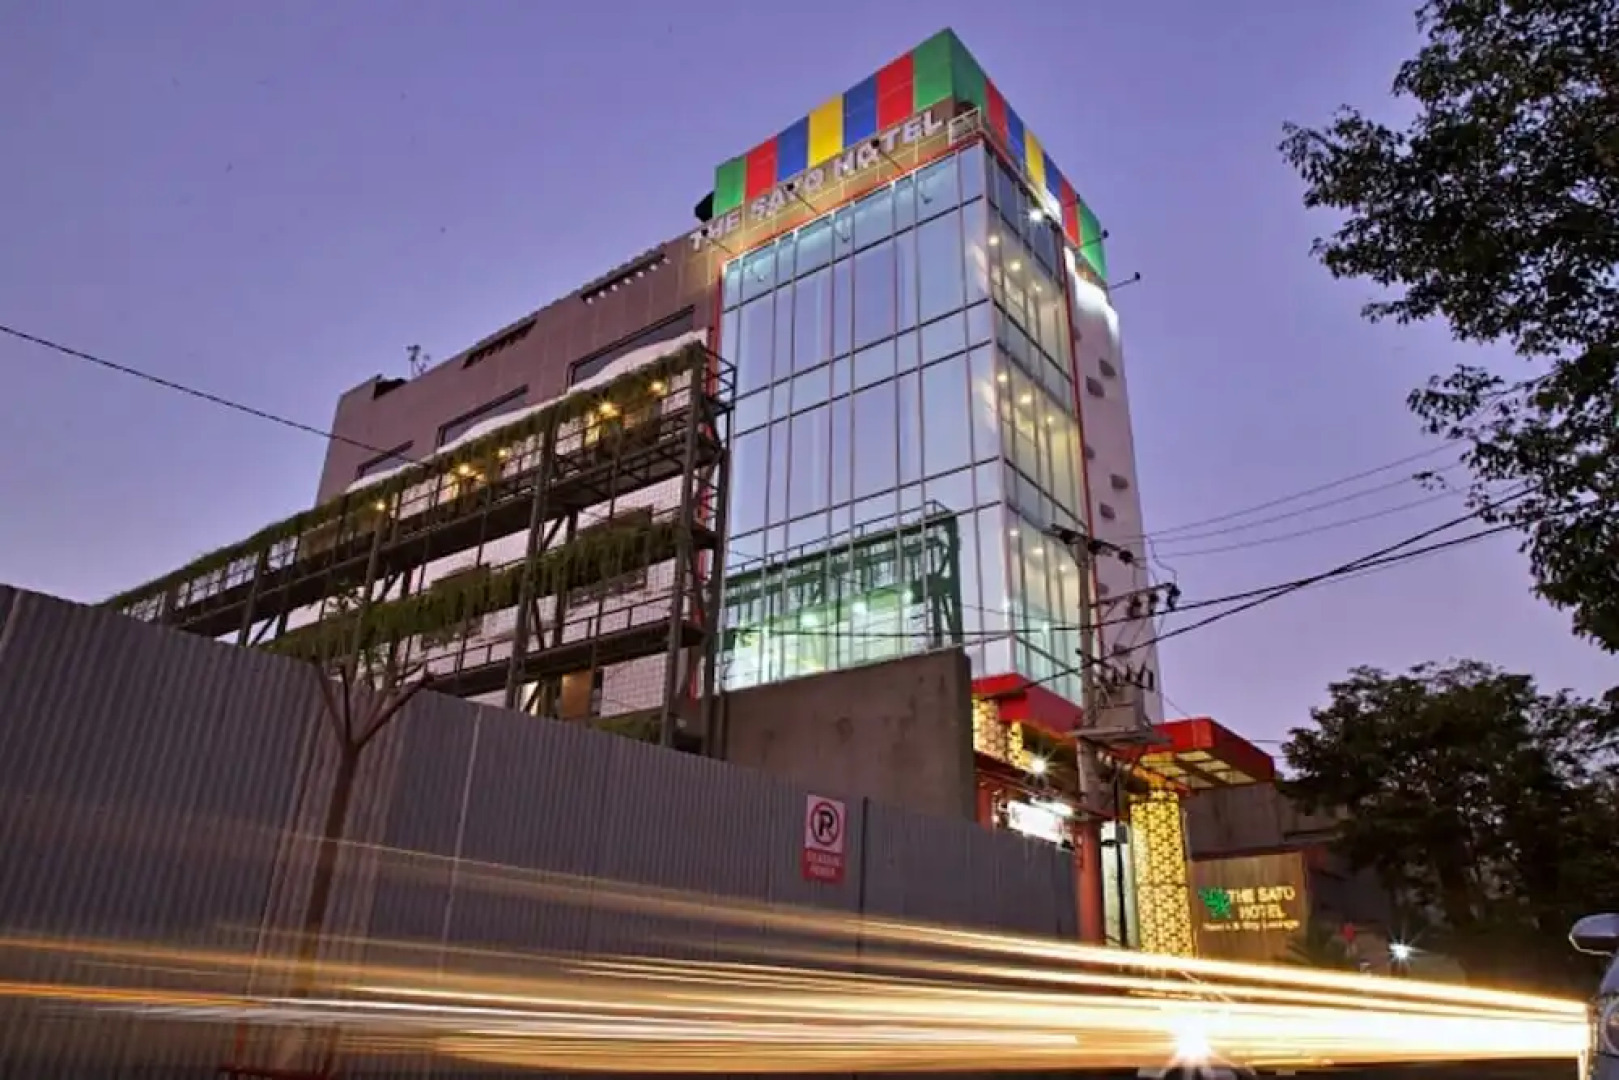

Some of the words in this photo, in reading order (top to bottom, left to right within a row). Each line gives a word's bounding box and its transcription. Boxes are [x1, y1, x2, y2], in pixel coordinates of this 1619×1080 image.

[689, 209, 740, 252] THE
[833, 108, 943, 178] HOTEL
[1226, 888, 1255, 904] THE
[1257, 885, 1296, 902] SATO
[1239, 904, 1287, 919] HOTEL
